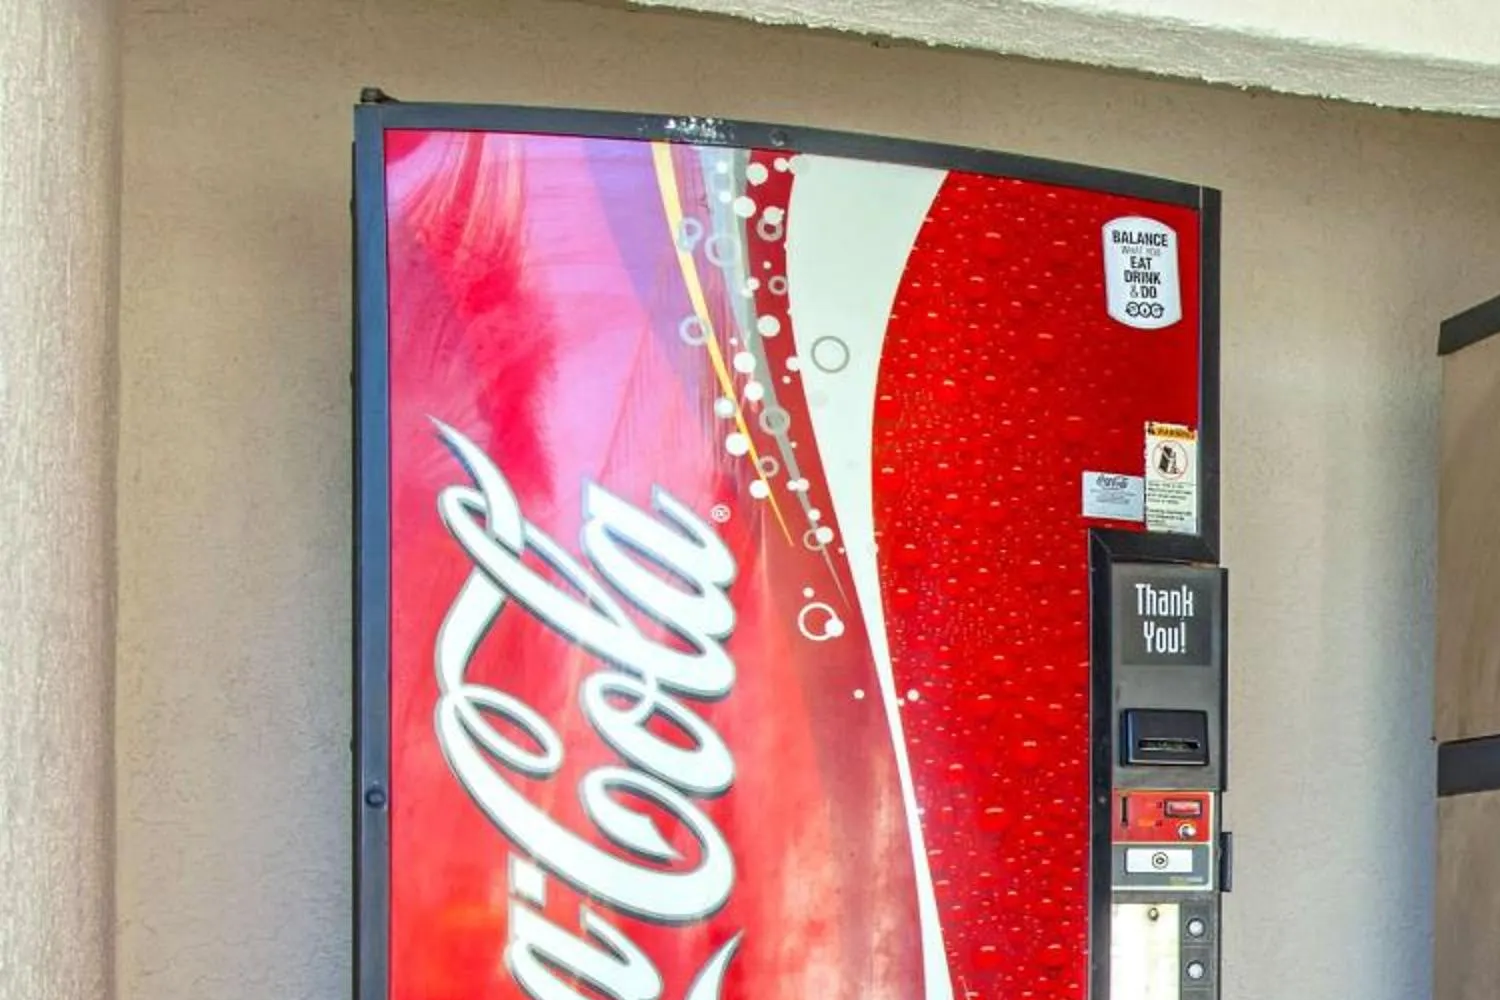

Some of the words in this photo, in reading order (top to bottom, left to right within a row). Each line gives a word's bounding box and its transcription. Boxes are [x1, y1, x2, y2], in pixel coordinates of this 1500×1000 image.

[1112, 230, 1169, 247] BALANCE
[1130, 256, 1152, 270] EAT
[1123, 270, 1161, 285] DRINK
[1129, 284, 1139, 298] &
[1140, 285, 1157, 299] DO
[1135, 583, 1194, 617] Thank
[1143, 621, 1186, 654] You!
